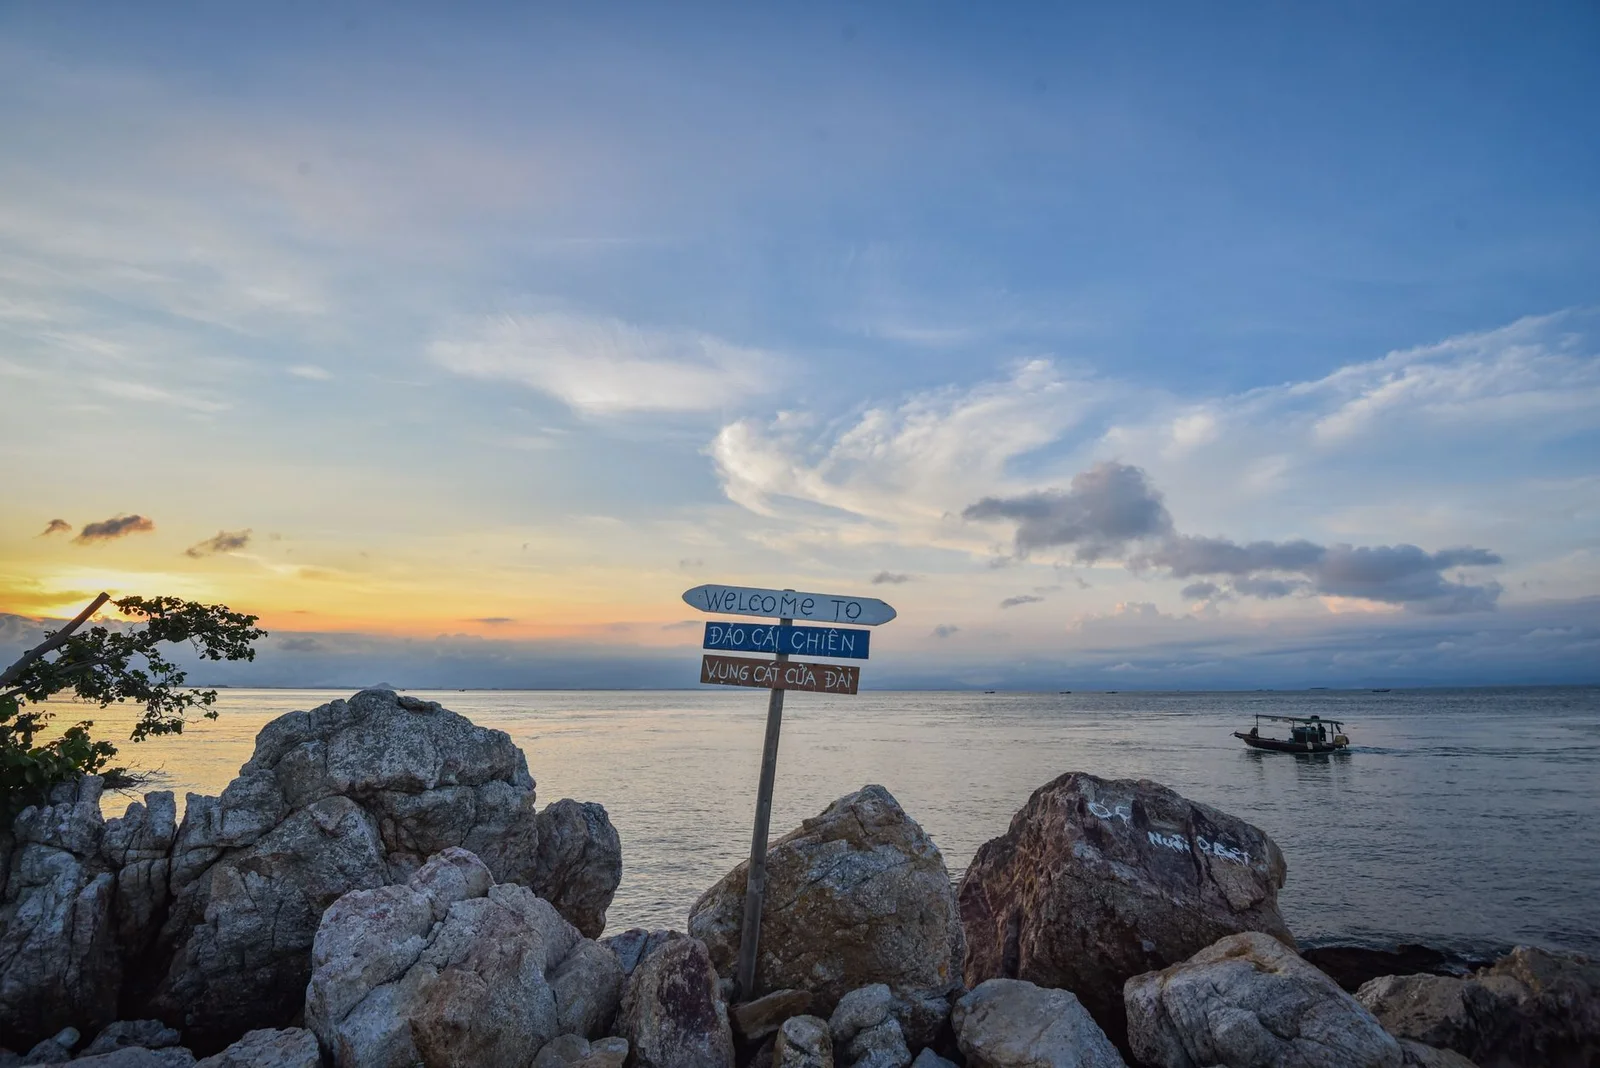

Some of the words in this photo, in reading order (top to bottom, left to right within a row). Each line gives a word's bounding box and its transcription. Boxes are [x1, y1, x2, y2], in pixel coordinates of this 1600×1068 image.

[830, 600, 862, 622] TO
[753, 661, 781, 683] CÁT
[785, 664, 817, 686] CỬA
